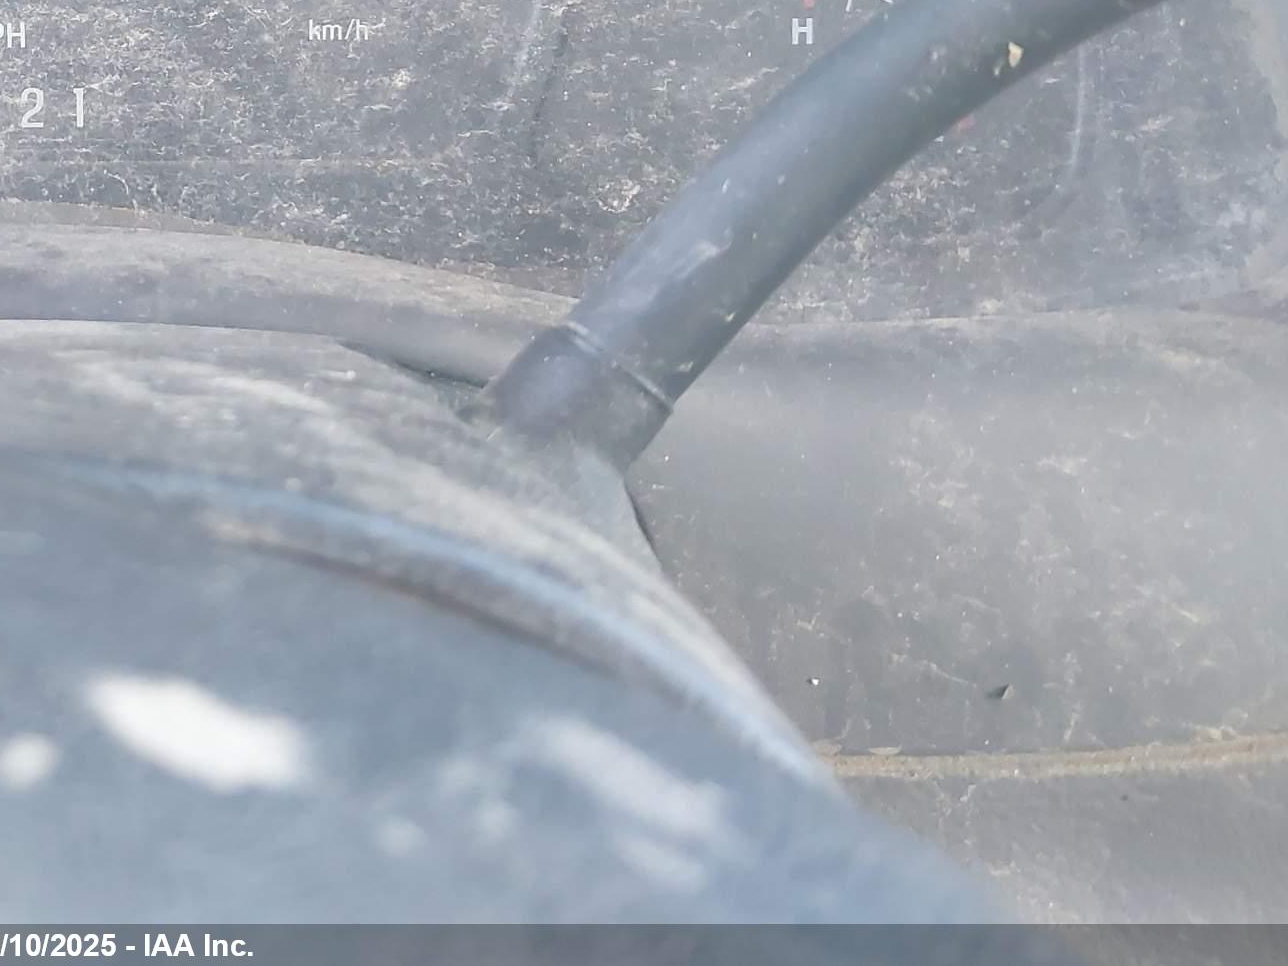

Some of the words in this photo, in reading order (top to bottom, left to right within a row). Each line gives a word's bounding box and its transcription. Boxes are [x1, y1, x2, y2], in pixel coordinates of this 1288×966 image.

[308, 19, 370, 41] km/h
[791, 17, 813, 45] H
[20, 88, 45, 129] 2
